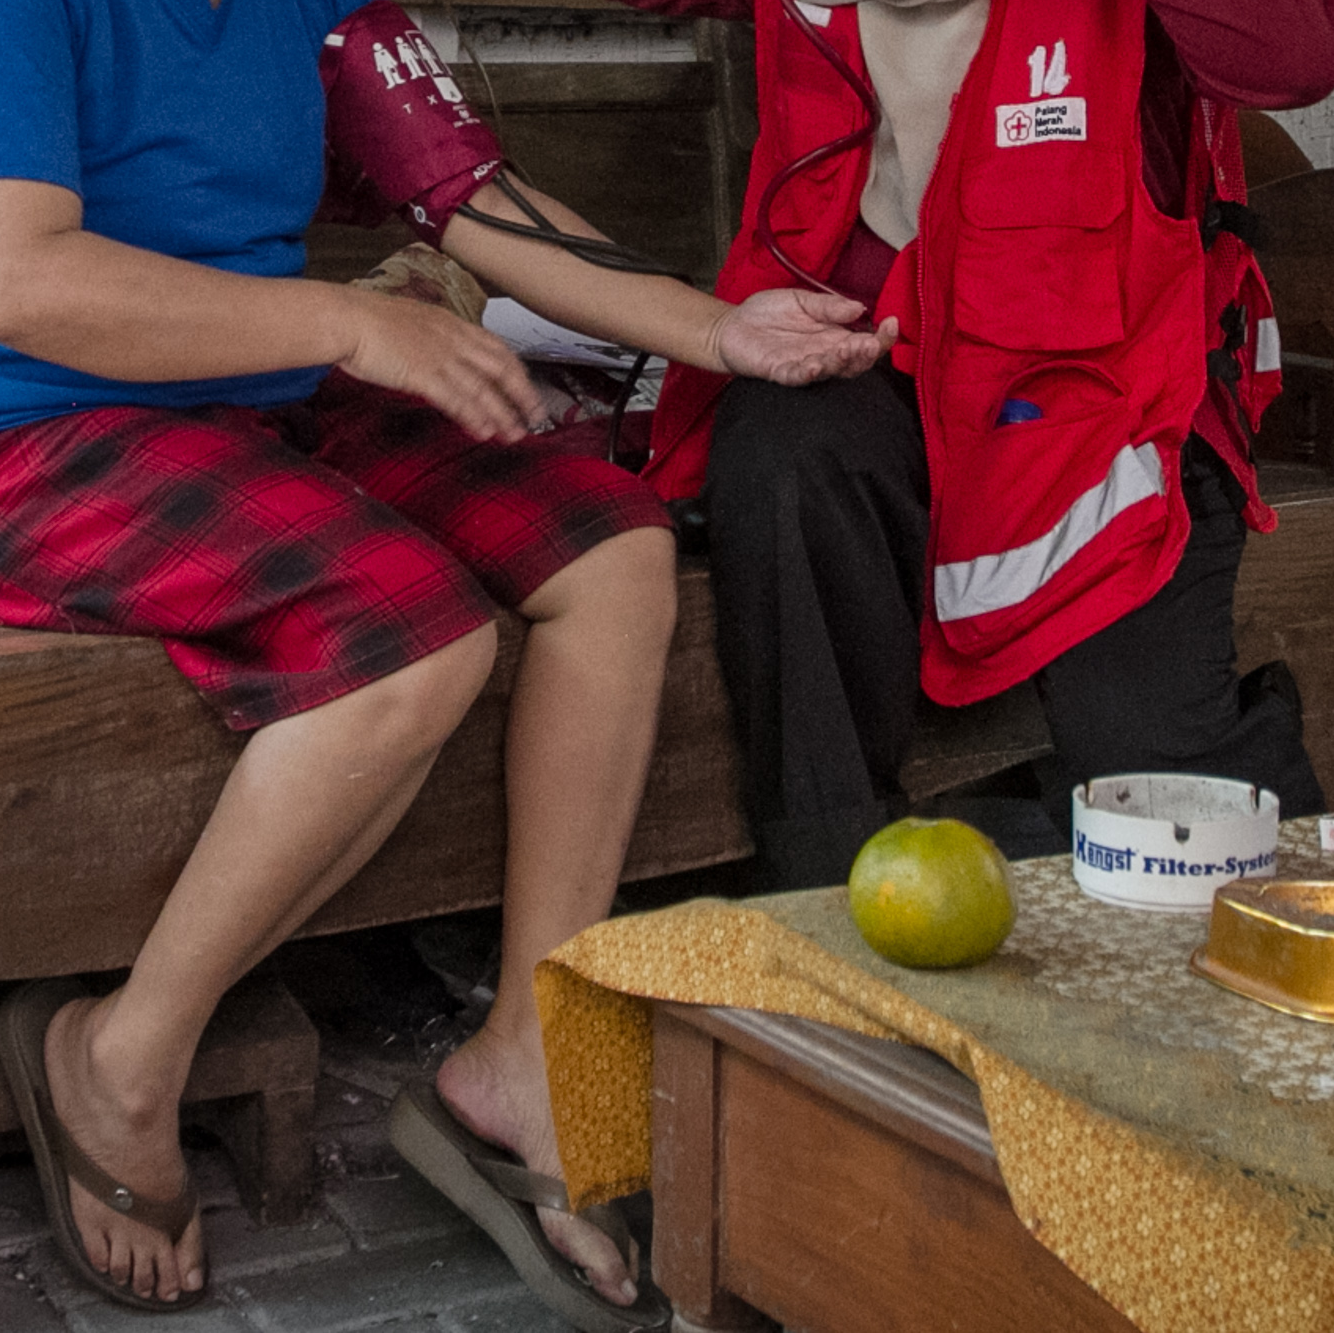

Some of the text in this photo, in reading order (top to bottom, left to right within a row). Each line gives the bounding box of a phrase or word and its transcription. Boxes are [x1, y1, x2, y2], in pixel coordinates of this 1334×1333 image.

[1035, 106, 1067, 117] Palang
[1035, 115, 1063, 127] Merah
[1035, 126, 1081, 137] Indonesia
